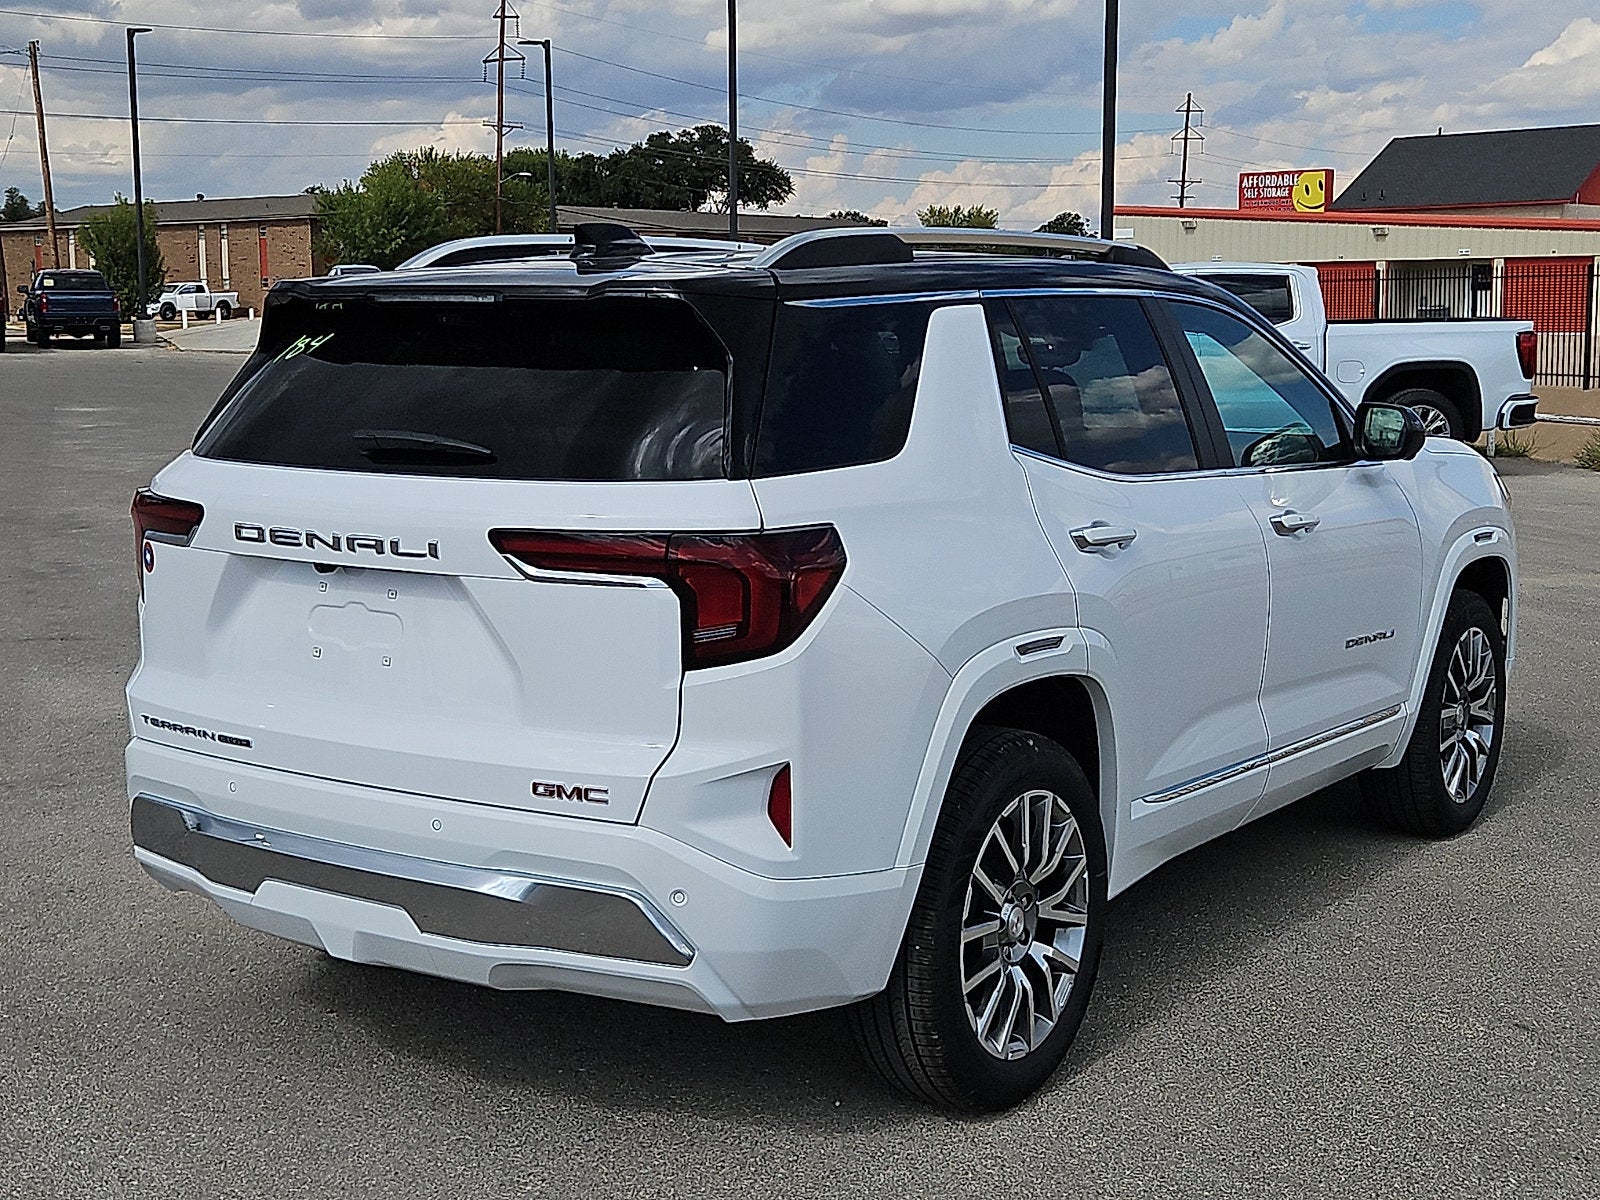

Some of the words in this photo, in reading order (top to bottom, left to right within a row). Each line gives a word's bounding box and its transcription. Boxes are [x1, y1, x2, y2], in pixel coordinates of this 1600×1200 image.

[1242, 173, 1300, 189] AFFORDABLE
[1243, 188, 1259, 199] SELF
[1260, 187, 1290, 198] STORAGE
[233, 521, 440, 560] DENALI
[140, 713, 217, 742] TERRAIN
[531, 780, 610, 806] GMC
